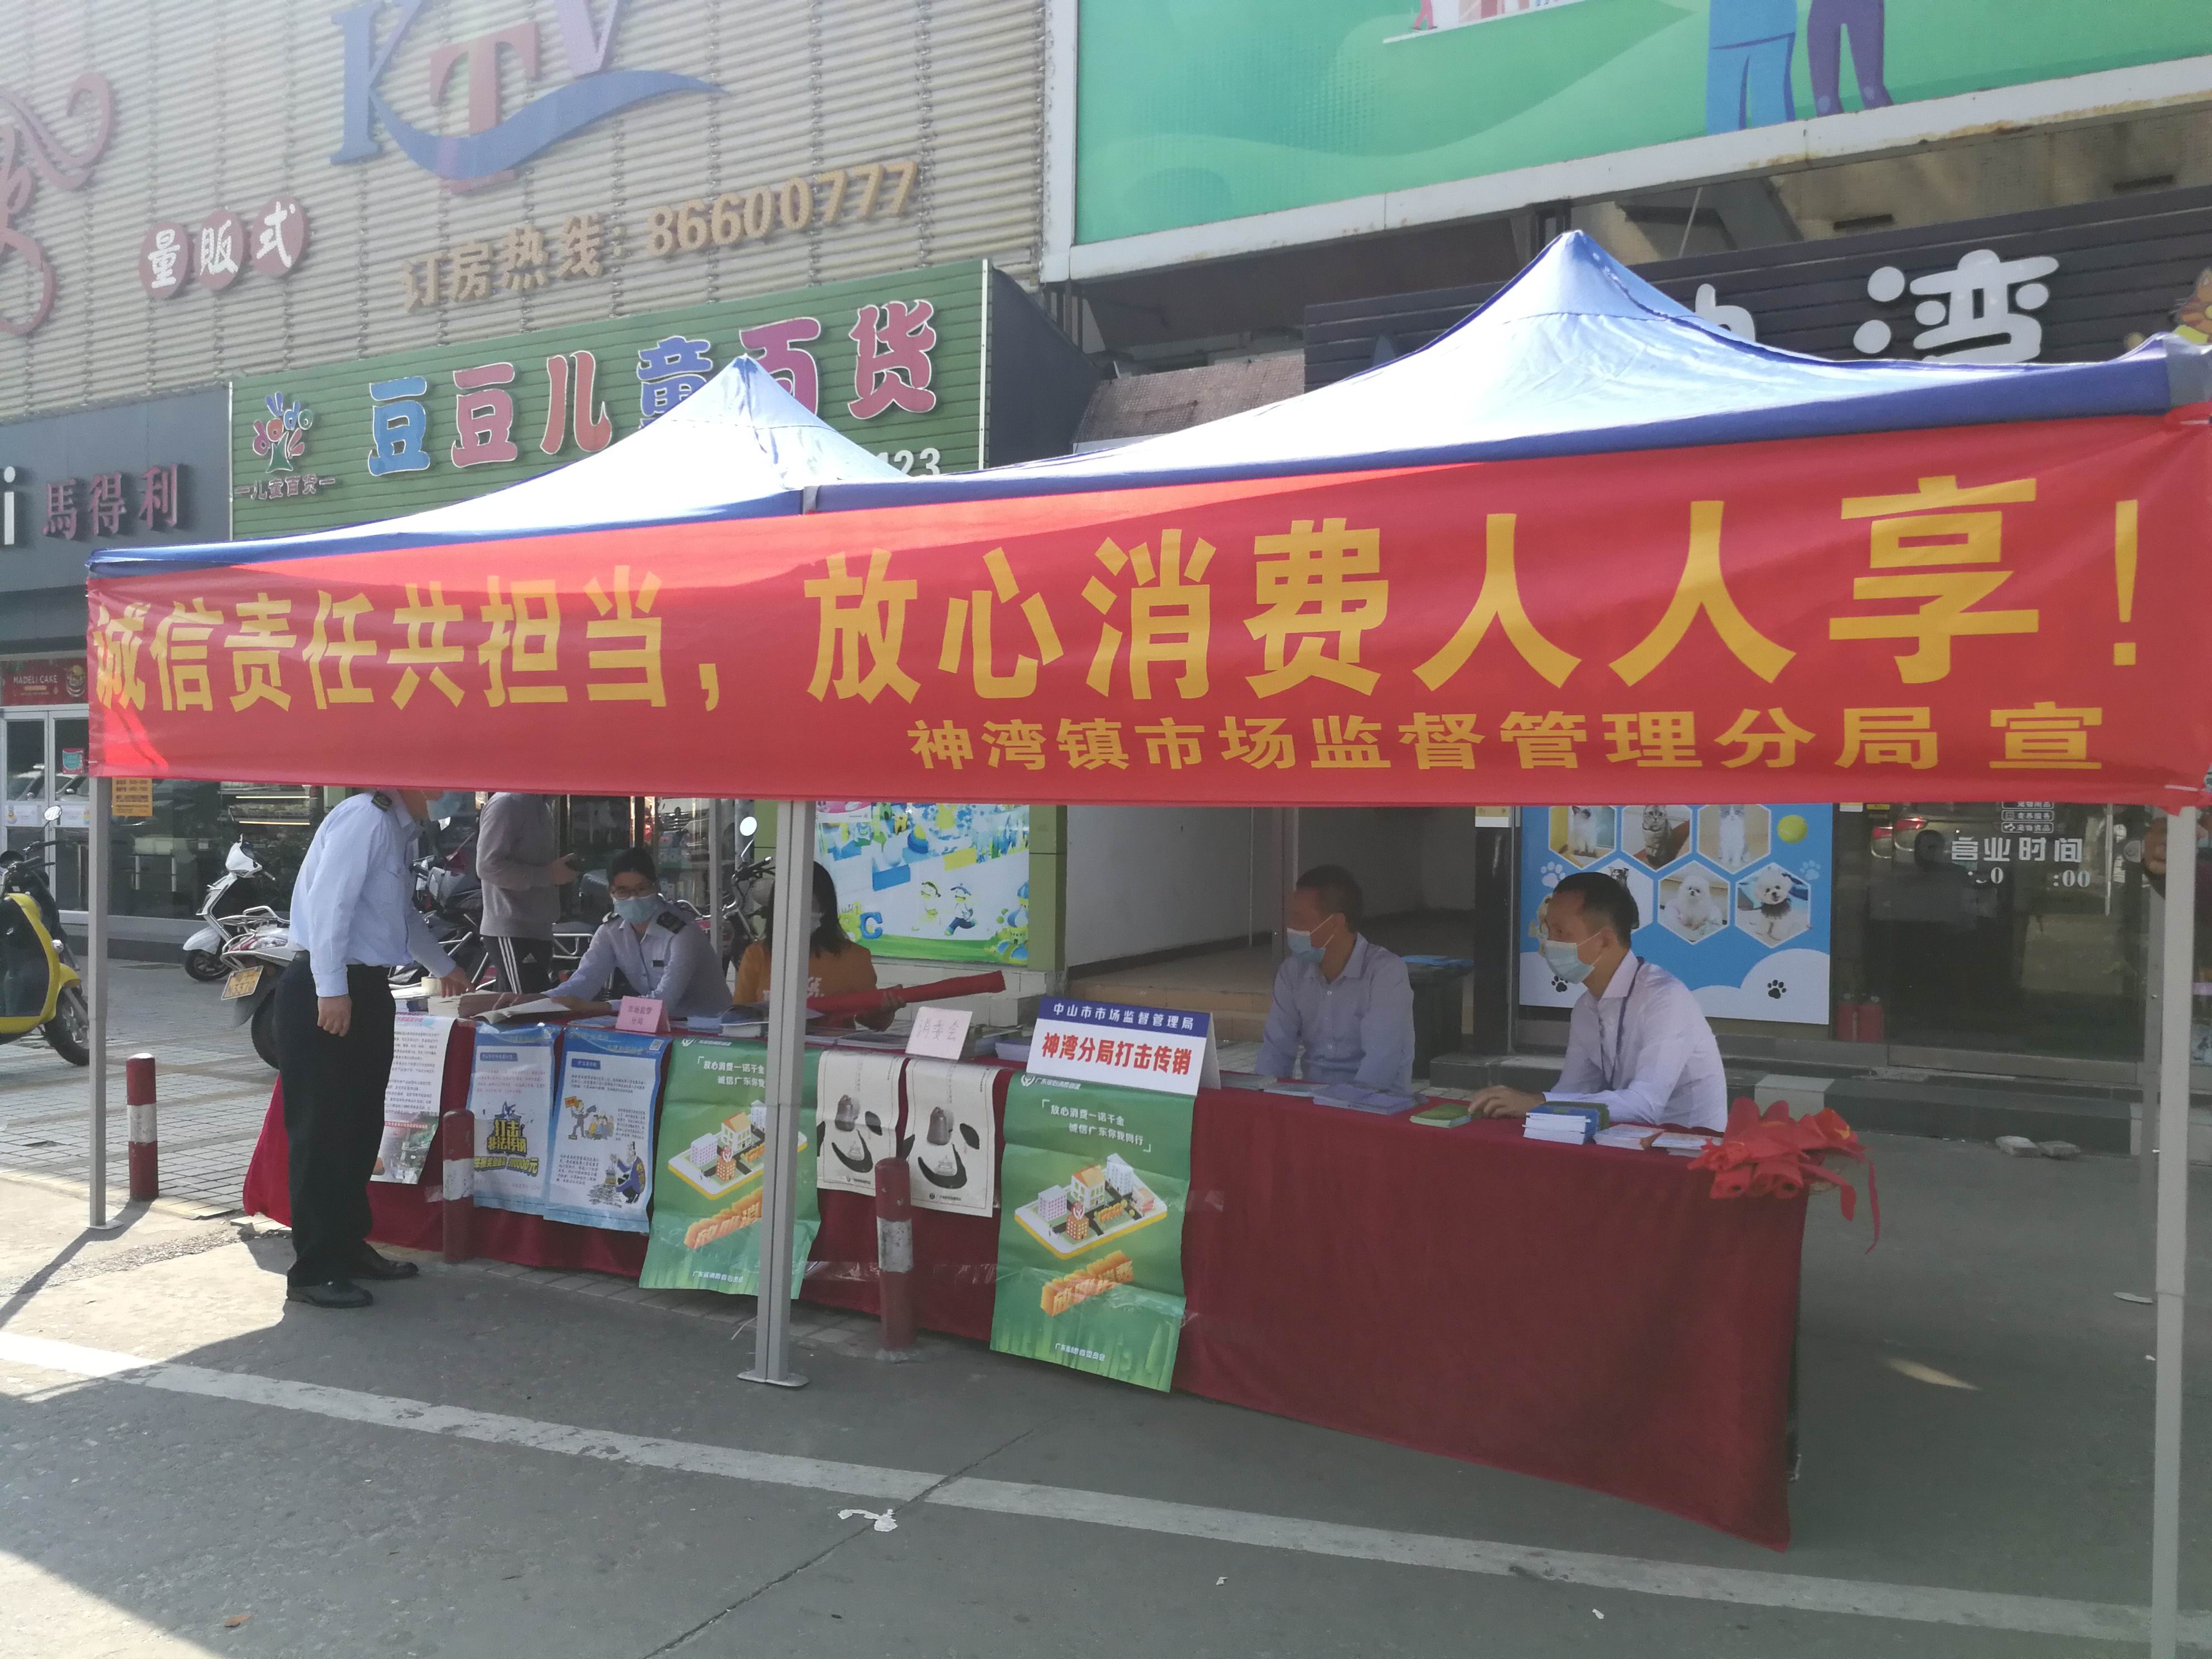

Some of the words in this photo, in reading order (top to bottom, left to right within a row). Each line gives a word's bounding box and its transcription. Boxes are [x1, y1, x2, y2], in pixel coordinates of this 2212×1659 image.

[330, 0, 619, 195] KTV
[646, 161, 918, 257] 86600777
[368, 299, 937, 476] 豆豆儿童百货
[42, 464, 178, 539] 馬得利
[40, 675, 57, 683] CAKE
[907, 707, 1938, 770] 神湾镇市场监督管理分局
[1989, 701, 2103, 769] 宣
[1952, 837, 2083, 863] 营业时间
[1053, 1002, 1194, 1030] 中山市市场监督管理局
[1041, 1032, 1192, 1075] 神湾分局打击传销
[495, 1119, 519, 1137] 打击
